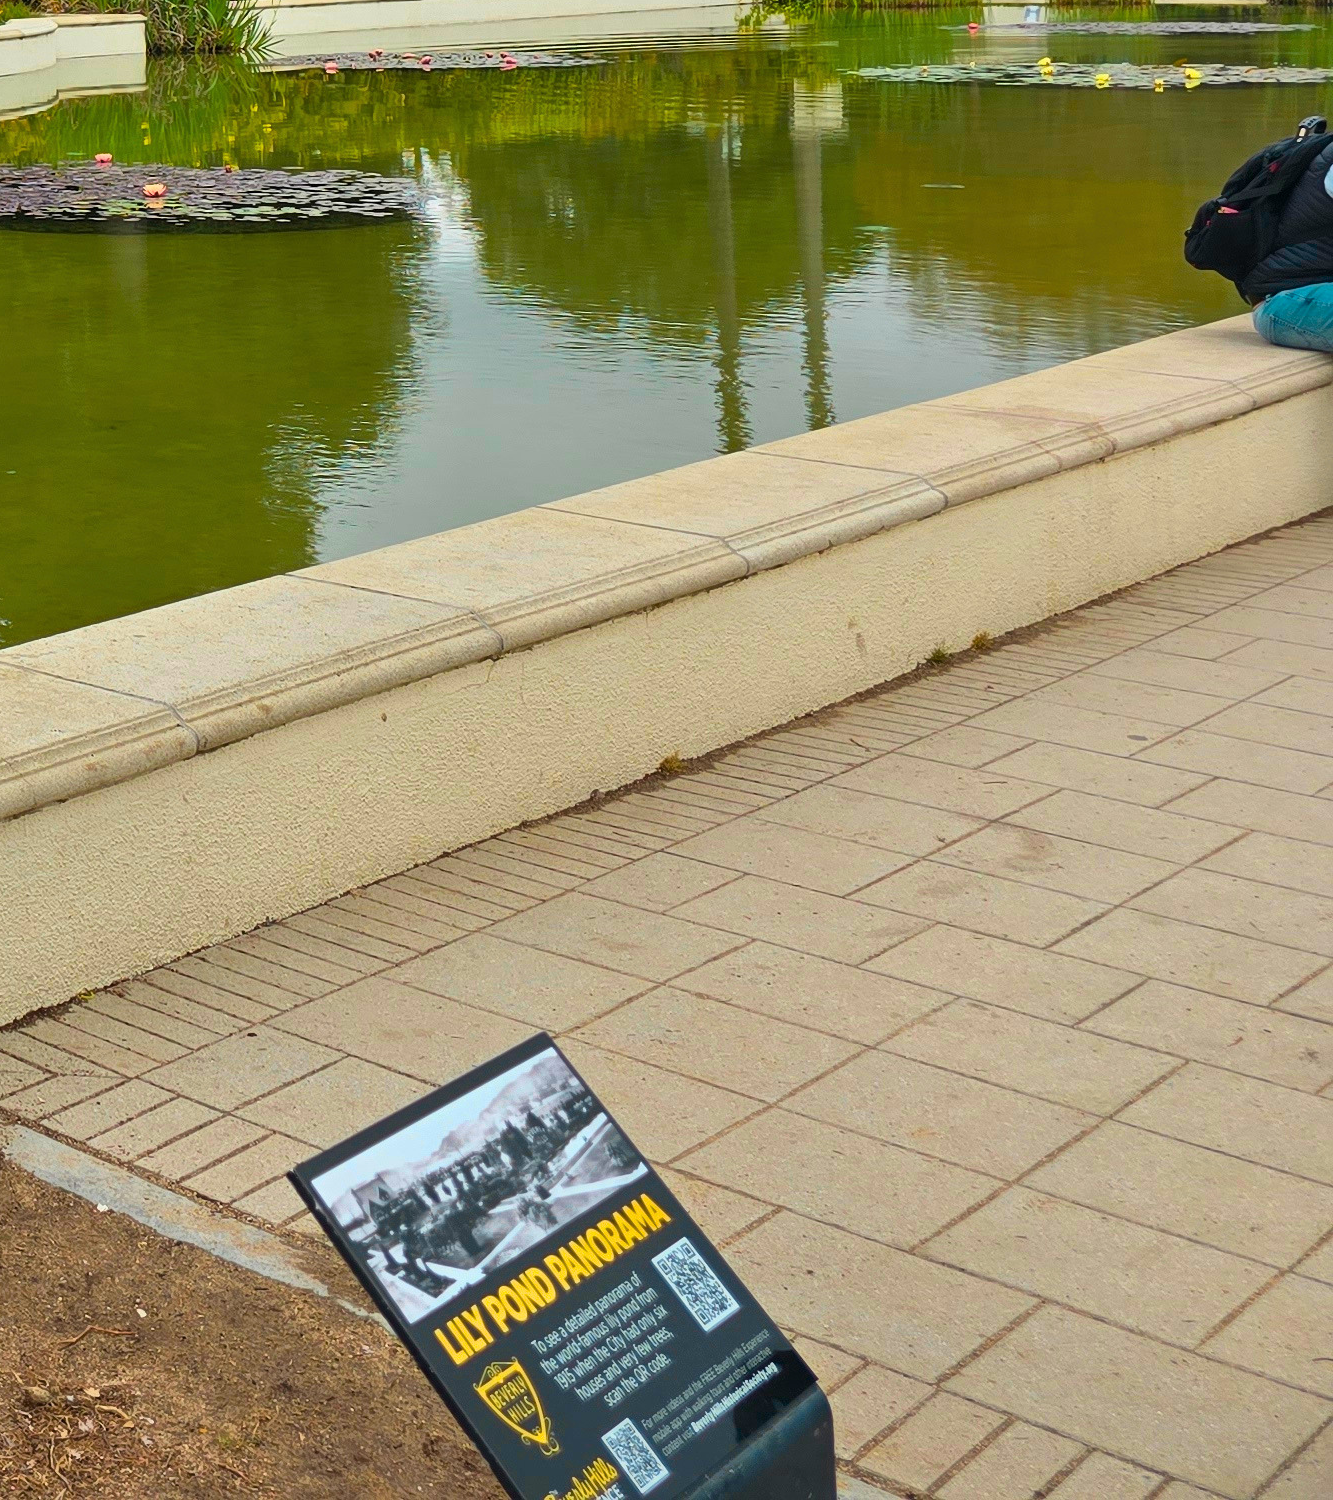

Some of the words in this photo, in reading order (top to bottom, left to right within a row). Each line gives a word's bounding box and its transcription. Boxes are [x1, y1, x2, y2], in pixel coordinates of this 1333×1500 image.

[434, 1305, 495, 1366] LILY
[481, 1267, 558, 1334] POND
[544, 1194, 671, 1291] PANORAMA
[530, 1340, 548, 1355] To
[544, 1331, 562, 1348] see
[558, 1326, 569, 1338] a
[565, 1302, 599, 1333] detailed
[594, 1281, 634, 1315] panorama
[630, 1270, 643, 1288] of
[540, 1358, 560, 1375] the
[556, 1322, 610, 1365] world-famous
[603, 1313, 622, 1329] lily
[617, 1297, 641, 1324] pond
[635, 1288, 659, 1307] from
[554, 1367, 577, 1390] 1915
[573, 1356, 599, 1378] when
[592, 1346, 611, 1363] the
[606, 1334, 627, 1352] City
[620, 1321, 642, 1342] had
[638, 1312, 658, 1331] only
[653, 1304, 669, 1320] six
[574, 1374, 607, 1401] houses
[603, 1360, 623, 1382] and
[618, 1351, 640, 1370] very
[633, 1340, 653, 1358] few
[647, 1327, 675, 1348] trees,
[490, 1376, 527, 1409] BEVERLY
[507, 1396, 535, 1423] HILLS
[604, 1386, 626, 1407] scan
[620, 1376, 639, 1393] the
[634, 1365, 652, 1383] QR
[648, 1354, 672, 1374] code.
[583, 1457, 618, 1492] Hills
